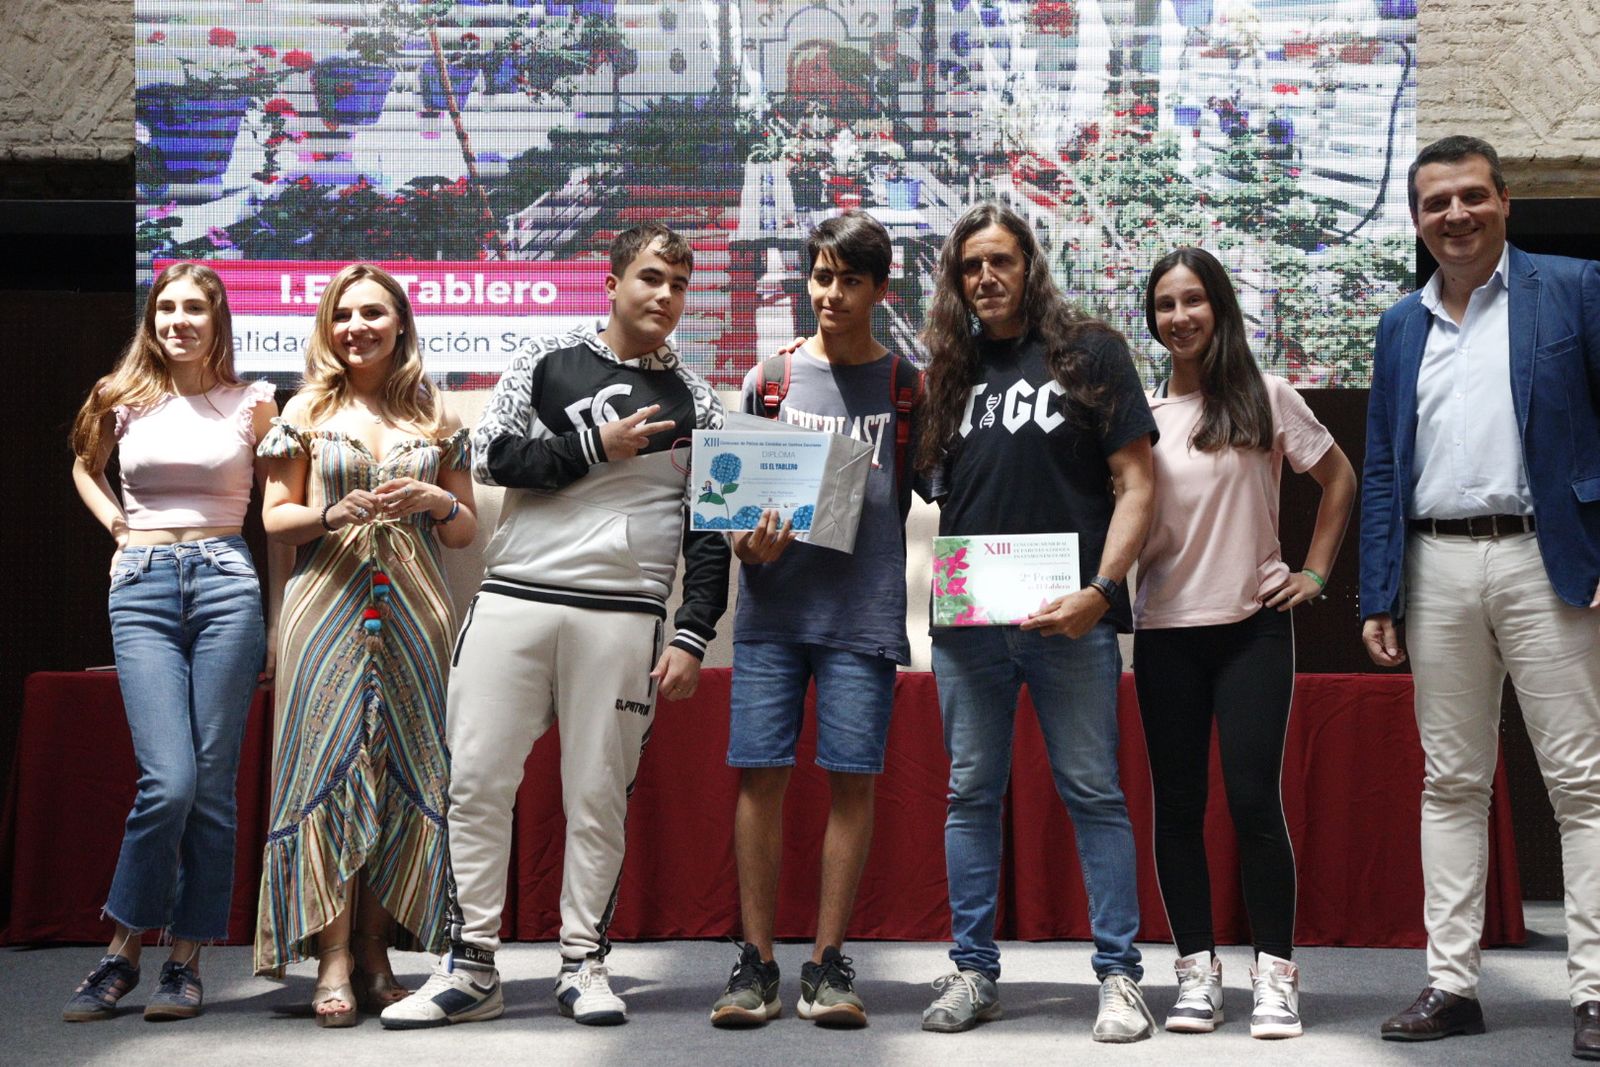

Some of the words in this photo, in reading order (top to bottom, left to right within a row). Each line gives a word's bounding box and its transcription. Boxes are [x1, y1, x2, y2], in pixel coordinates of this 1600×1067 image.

[280, 274, 331, 304] I.E
[391, 273, 557, 304] Tablero
[233, 330, 309, 353] alida
[418, 332, 490, 353] ación
[703, 437, 720, 448] XIII
[762, 450, 796, 459] DIPLOMA
[760, 463, 768, 471] IES
[768, 463, 775, 471] EL
[775, 463, 798, 471] TABLERO
[983, 541, 1011, 556] XIII
[465, 947, 475, 959] EL
